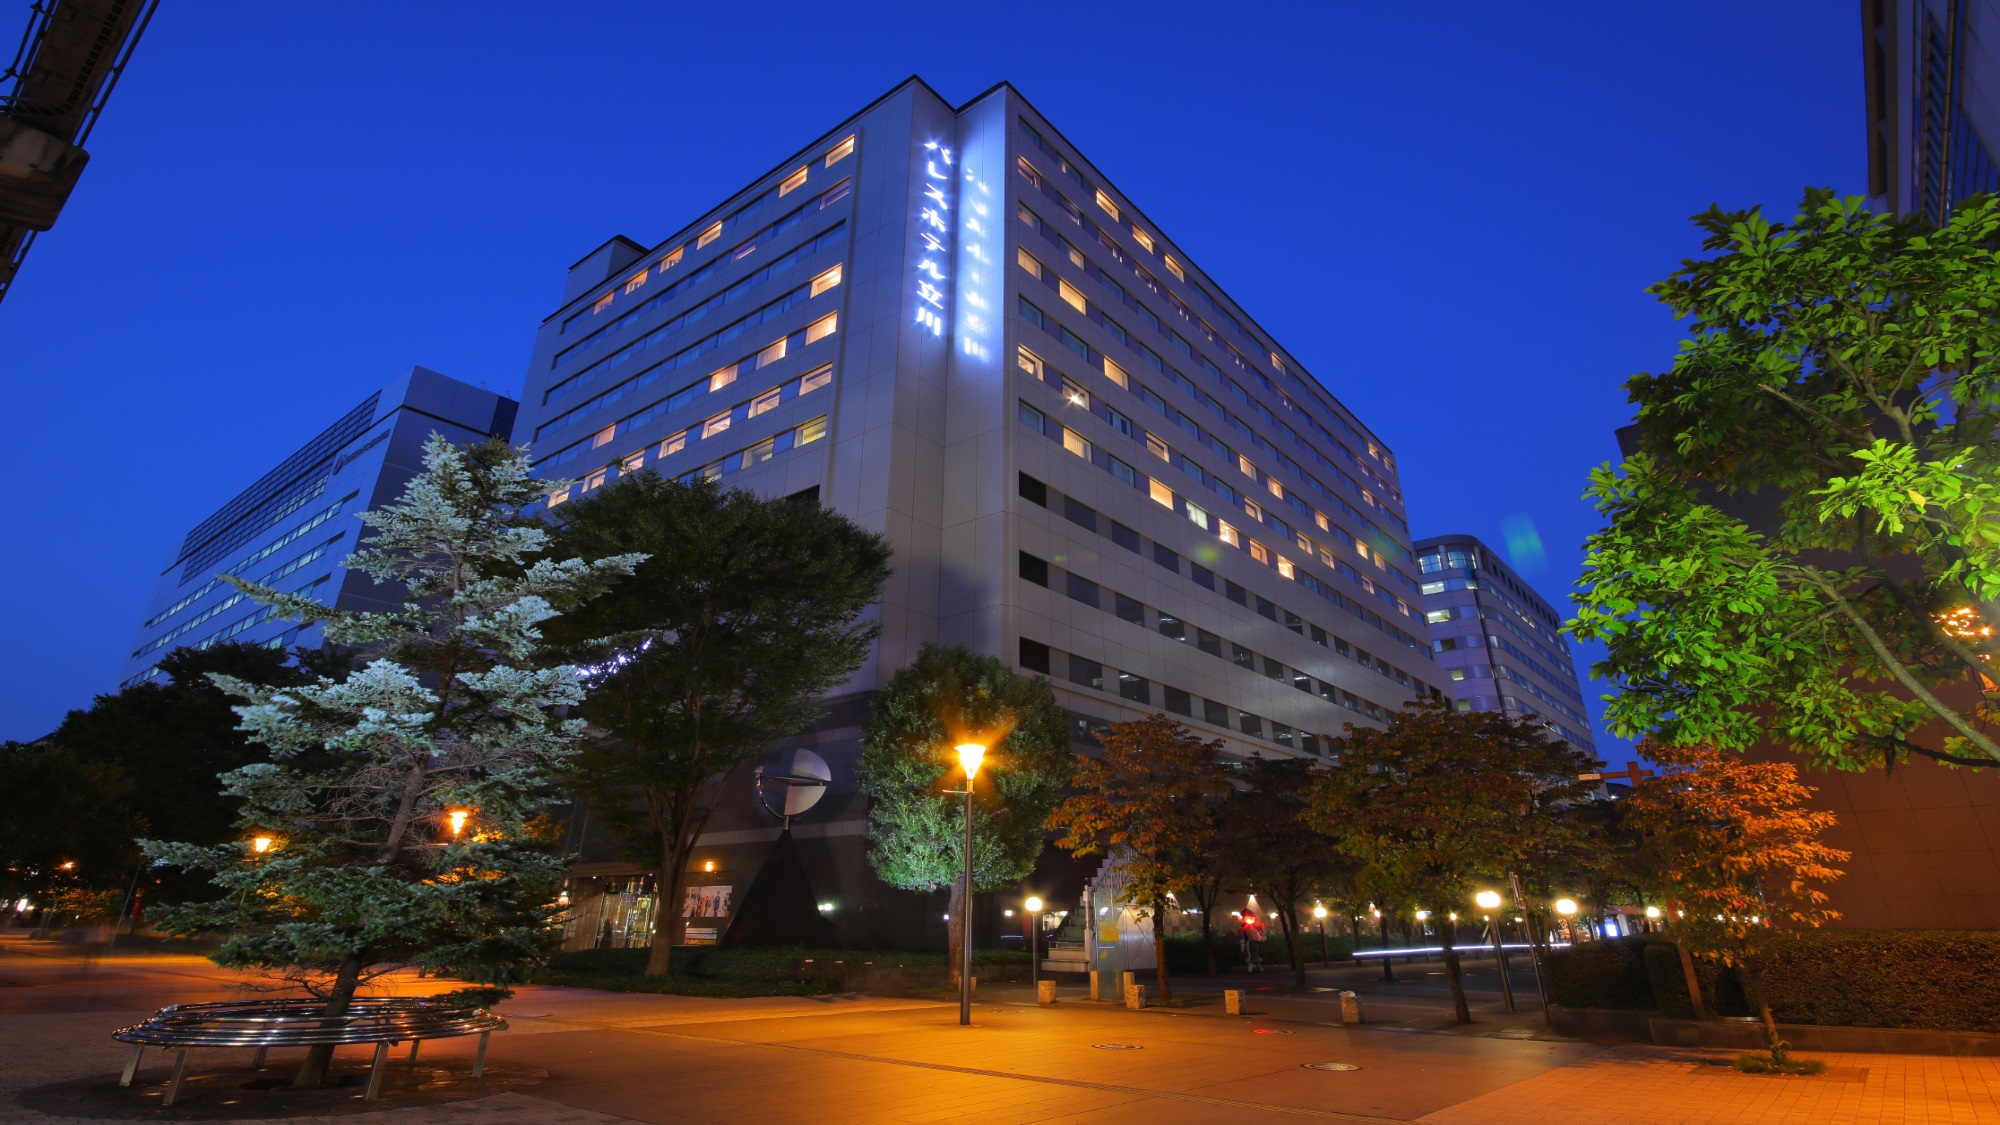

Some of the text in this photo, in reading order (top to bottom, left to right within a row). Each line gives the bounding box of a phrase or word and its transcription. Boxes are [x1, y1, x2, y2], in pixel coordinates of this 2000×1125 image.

[916, 140, 951, 337] パレスホテル立川
